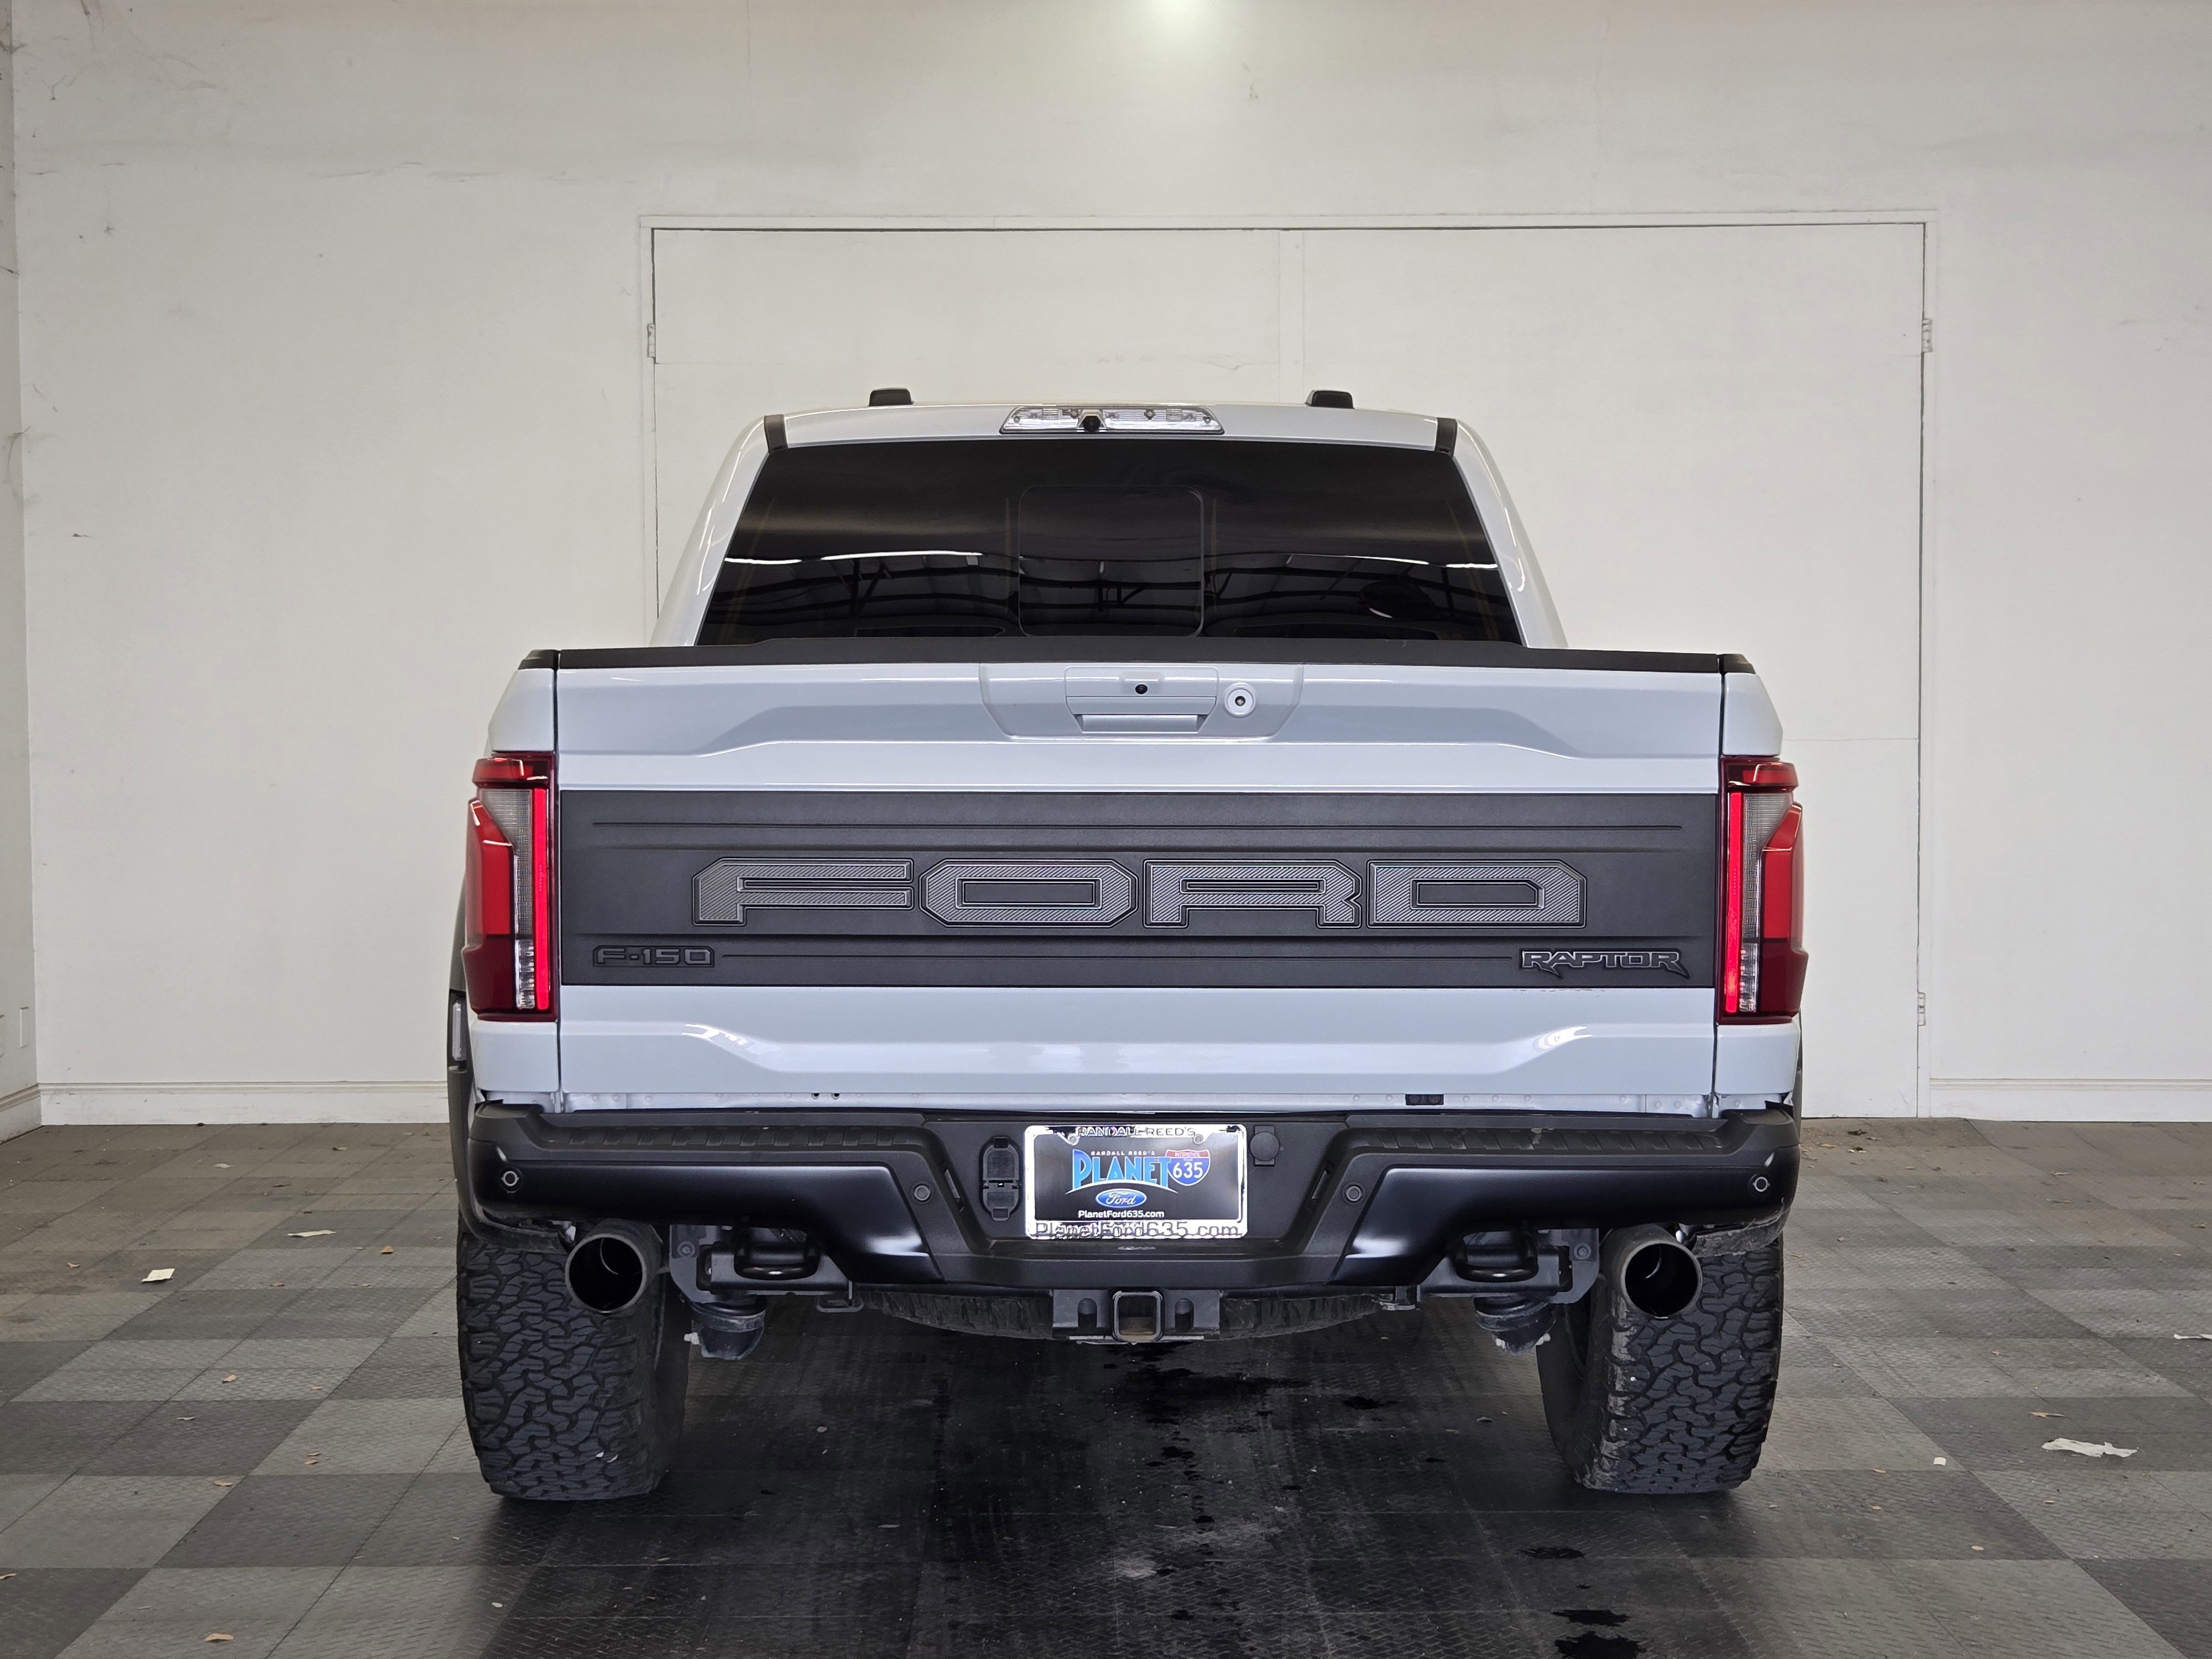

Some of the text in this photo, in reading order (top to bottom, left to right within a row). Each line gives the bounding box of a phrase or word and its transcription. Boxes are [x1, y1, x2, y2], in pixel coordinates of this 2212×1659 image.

[693, 857, 1586, 928] FORD
[597, 947, 712, 966] F-150
[1521, 950, 1689, 979] RAPTOR
[1145, 1126, 1196, 1136] REED'S
[1072, 1149, 1171, 1190] PLANET
[1173, 1161, 1203, 1178] 635
[1106, 1191, 1136, 1204] Ford
[1078, 1209, 1165, 1218] PlanetFord635.com
